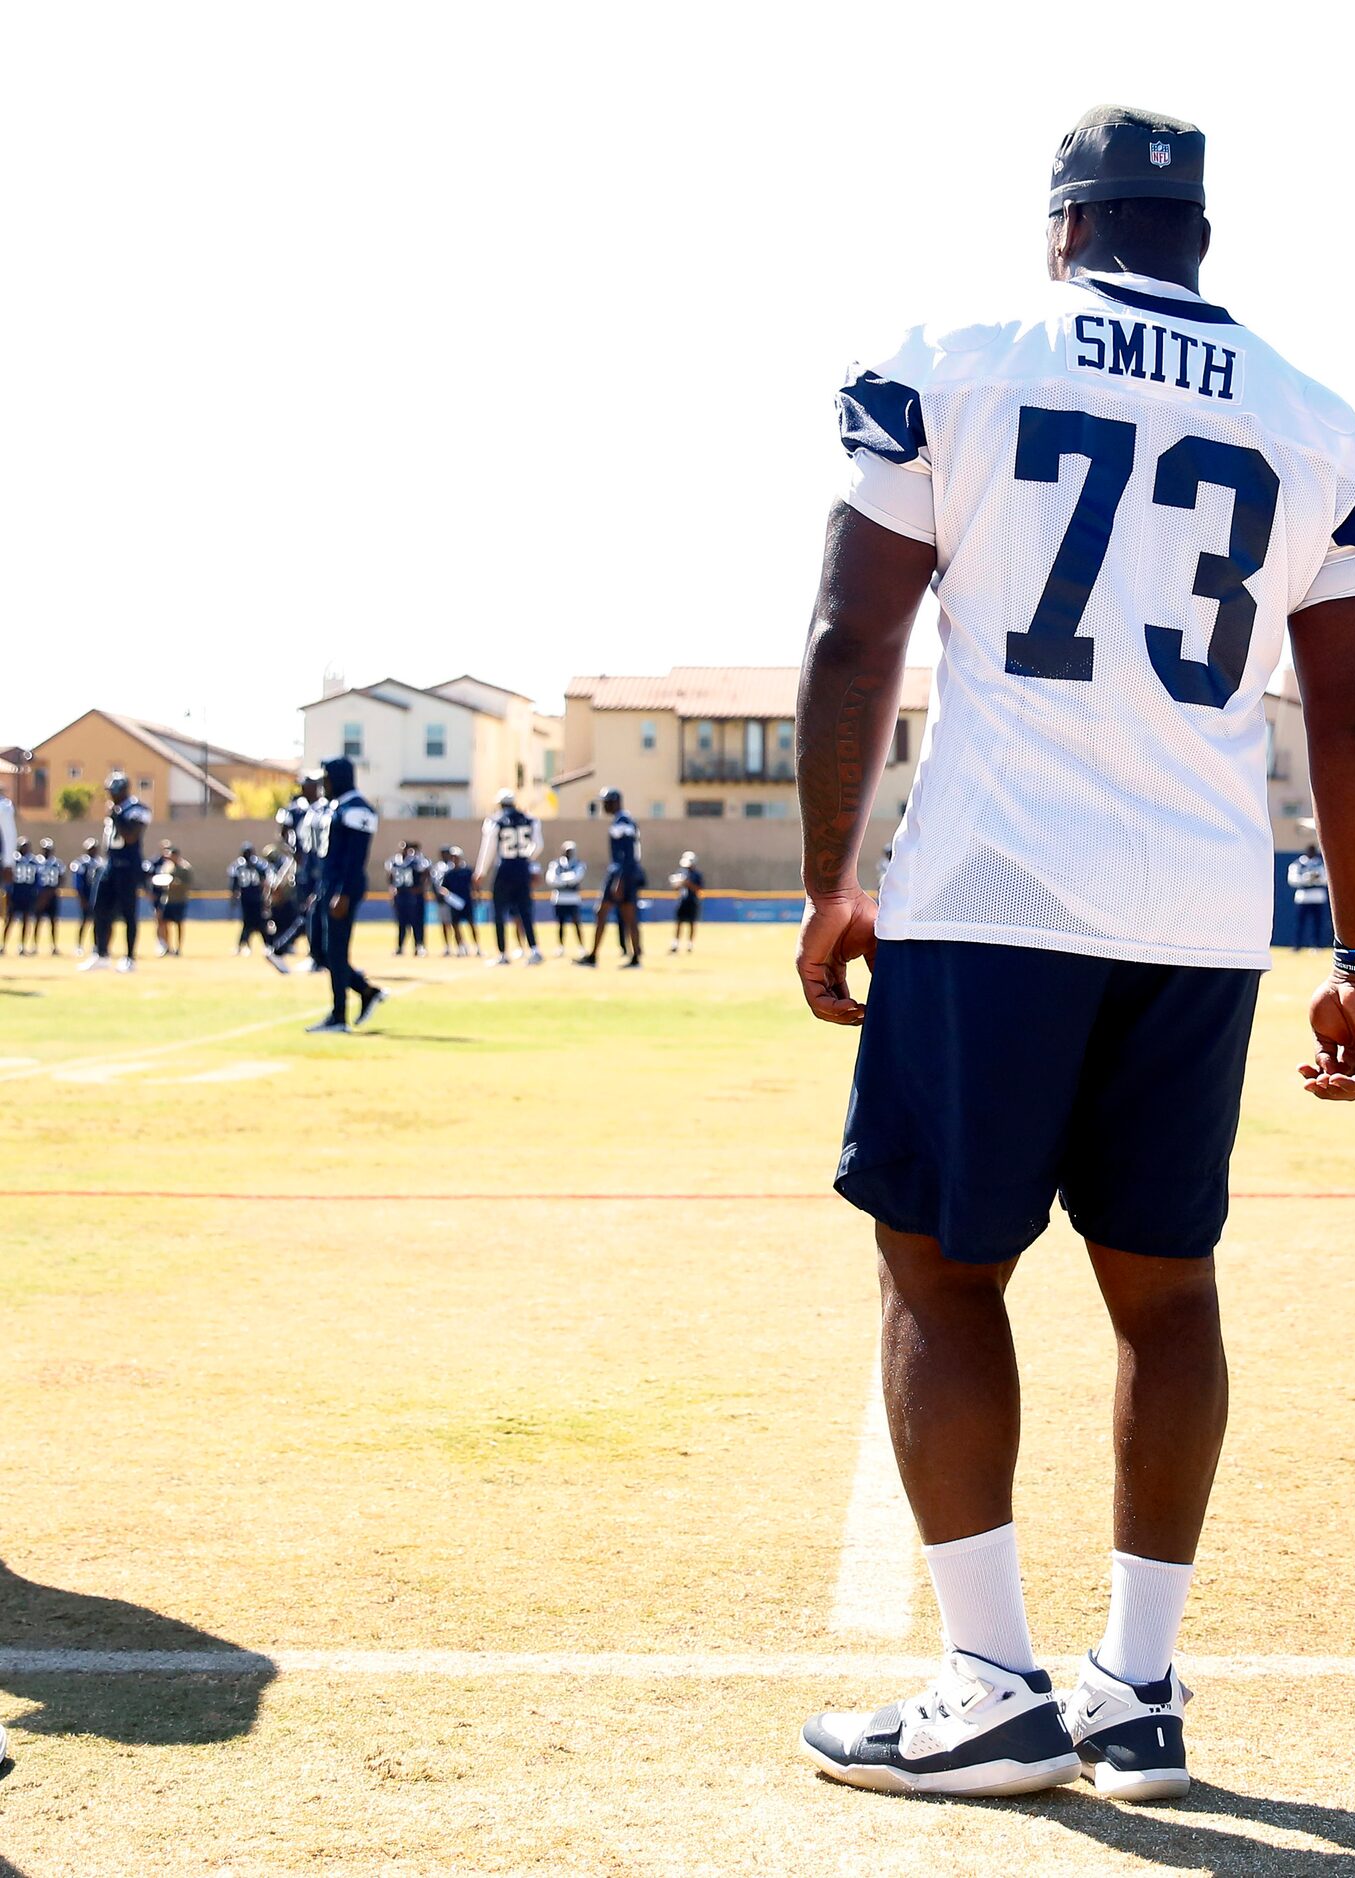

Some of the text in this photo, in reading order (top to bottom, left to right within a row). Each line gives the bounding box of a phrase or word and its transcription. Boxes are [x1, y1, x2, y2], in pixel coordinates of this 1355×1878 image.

[1152, 151, 1169, 163] NFL
[1075, 314, 1236, 400] SMITH
[1004, 405, 1281, 710] 73
[498, 825, 537, 860] 25
